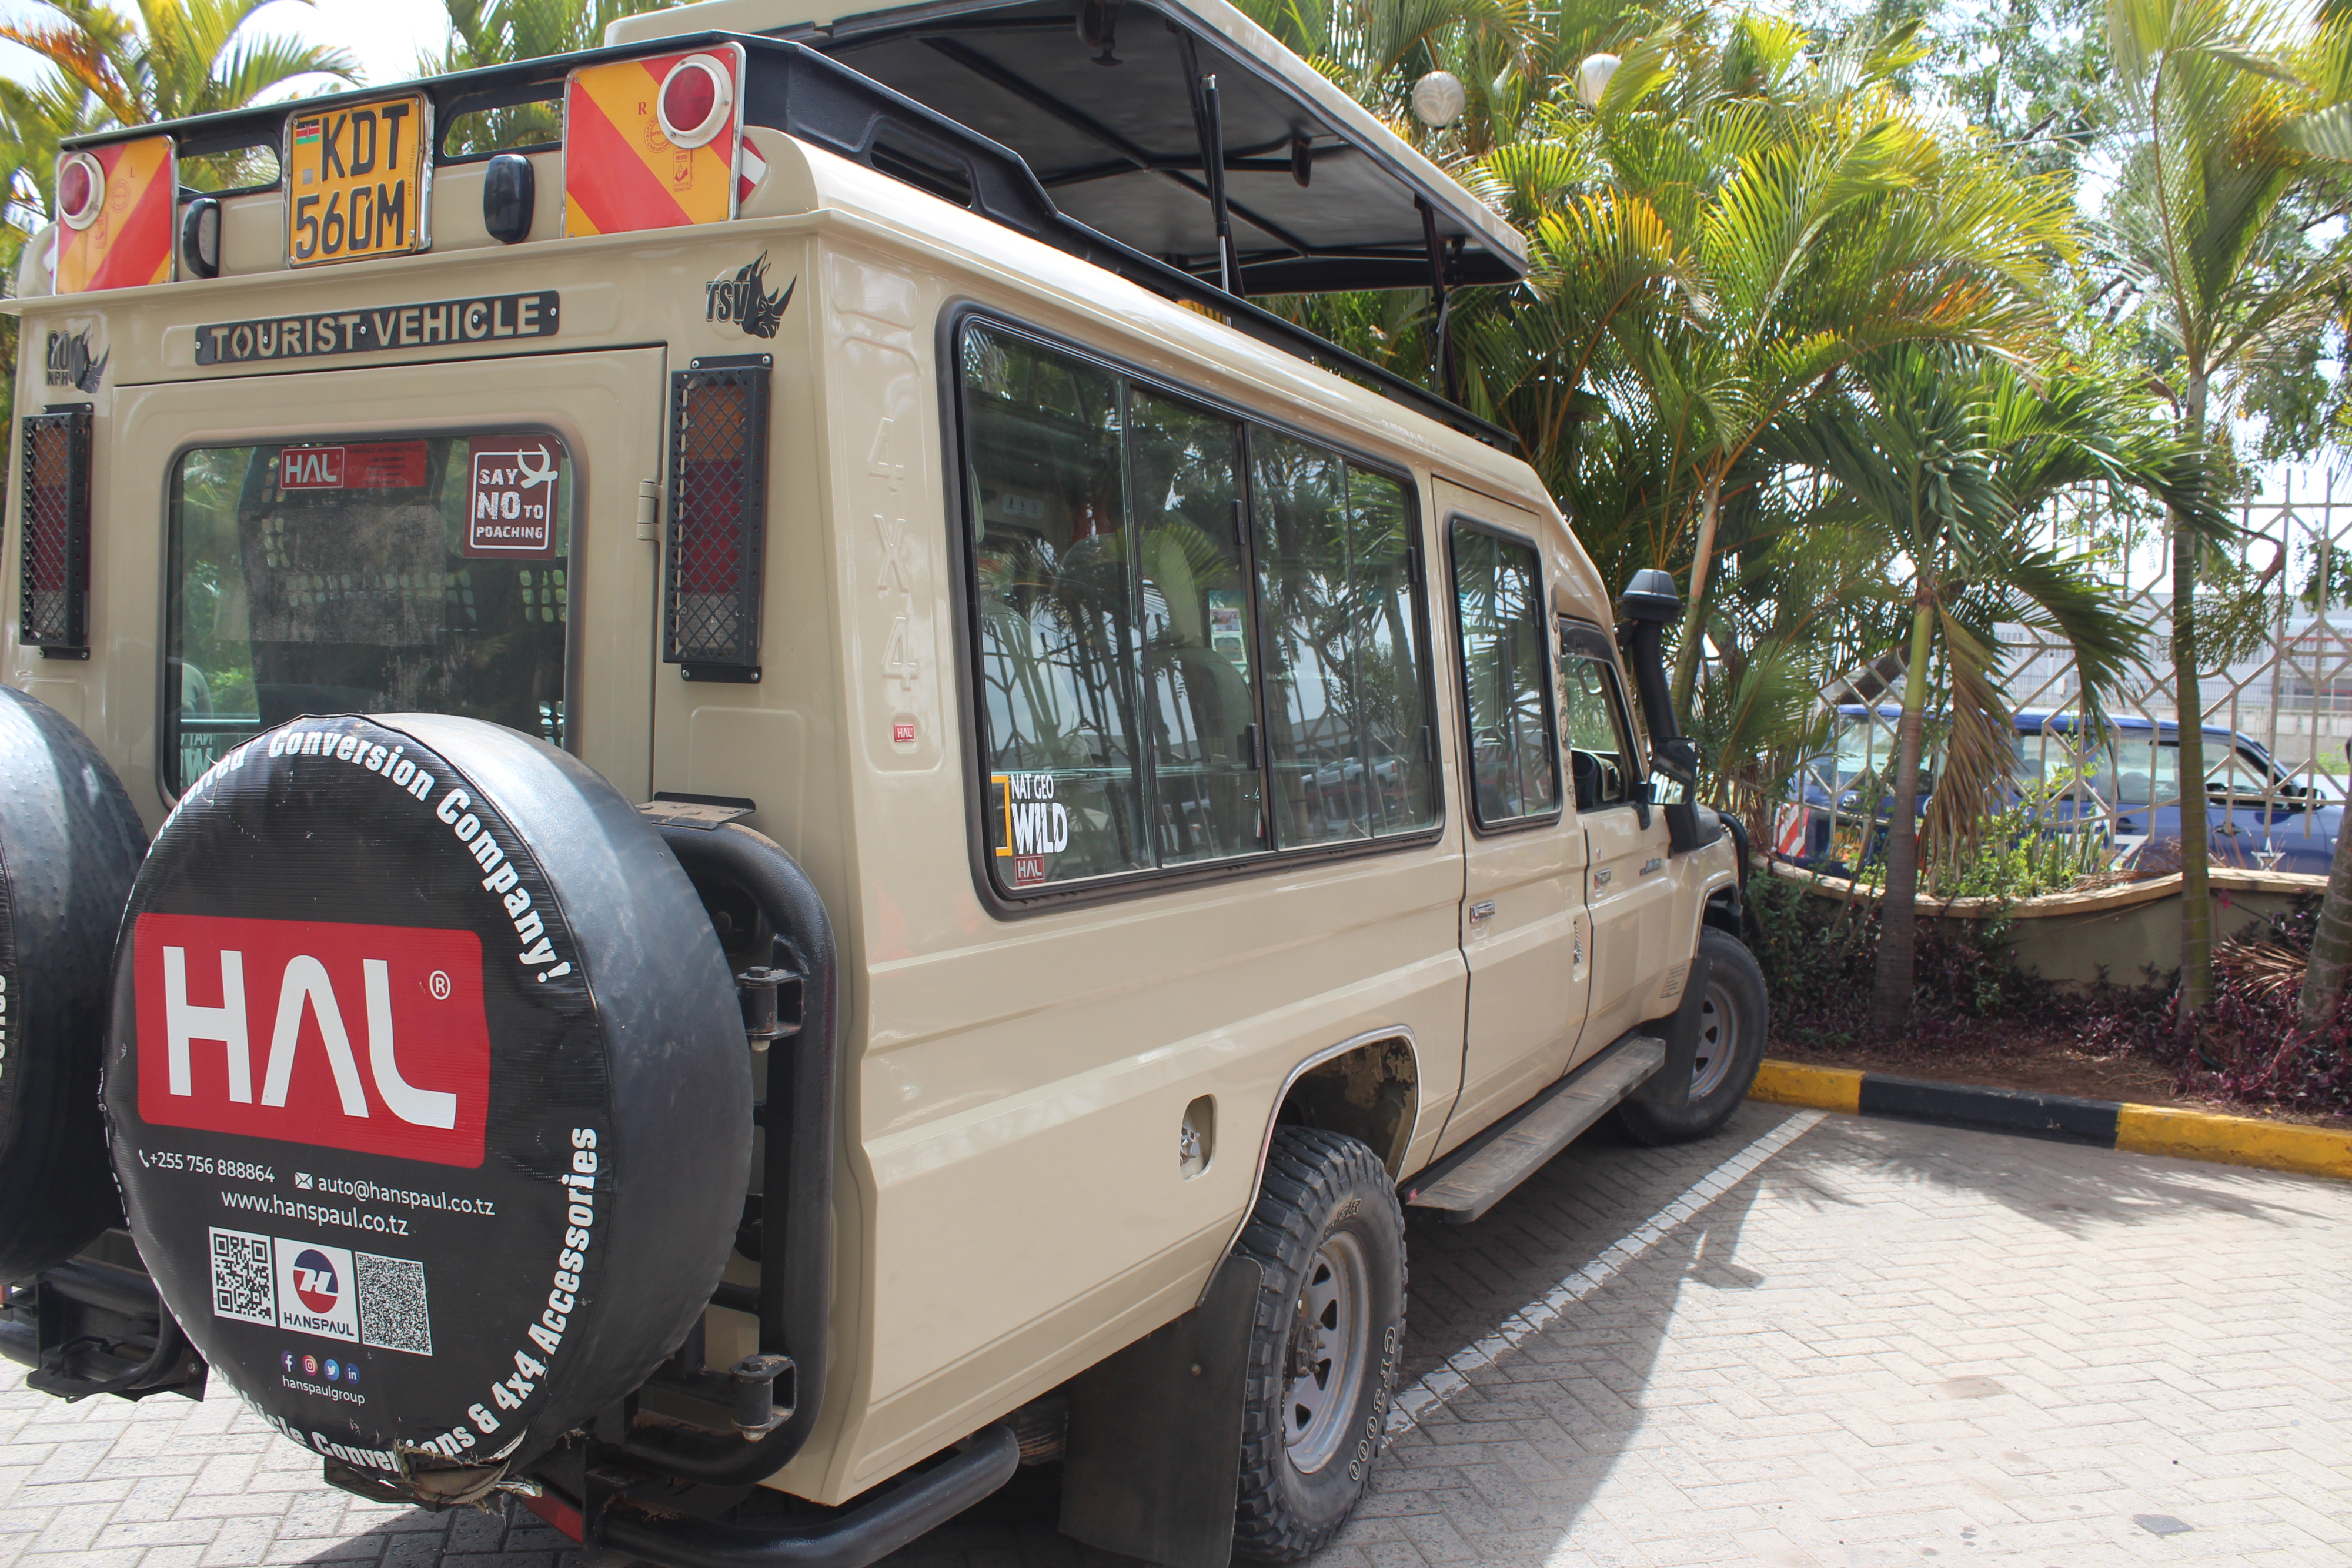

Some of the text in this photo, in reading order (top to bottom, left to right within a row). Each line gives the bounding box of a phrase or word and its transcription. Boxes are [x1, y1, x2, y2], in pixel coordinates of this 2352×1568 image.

[637, 102, 648, 115] R
[321, 103, 410, 182] KDT
[130, 166, 136, 178] L
[295, 179, 405, 259] 560M
[706, 280, 750, 323] TSV
[211, 296, 540, 360] TOURIST VEHICLE
[47, 330, 71, 370] 80
[285, 454, 338, 484] HAL
[479, 469, 519, 486] SAY
[477, 491, 544, 520] NO TO
[476, 526, 543, 539] POACHING
[897, 727, 913, 738] HAL
[1011, 774, 1054, 800] NAT GEO
[1011, 803, 1068, 855] WILD
[268, 727, 436, 802] Conversion
[436, 788, 572, 984] Company!
[1017, 859, 1043, 878] HAL
[163, 945, 457, 1130] HAL
[149, 1150, 275, 1183] +255 756 888864
[318, 1175, 495, 1216] auto@hanspaul.co.tz
[221, 1190, 409, 1236] www.hanspaul.co.tz
[467, 1403, 501, 1435] &
[491, 1349, 546, 1411] 4x4
[527, 1127, 599, 1355] Accessories
[283, 1311, 355, 1337] HANSPAUL
[282, 1375, 366, 1406] hanspaulgroup
